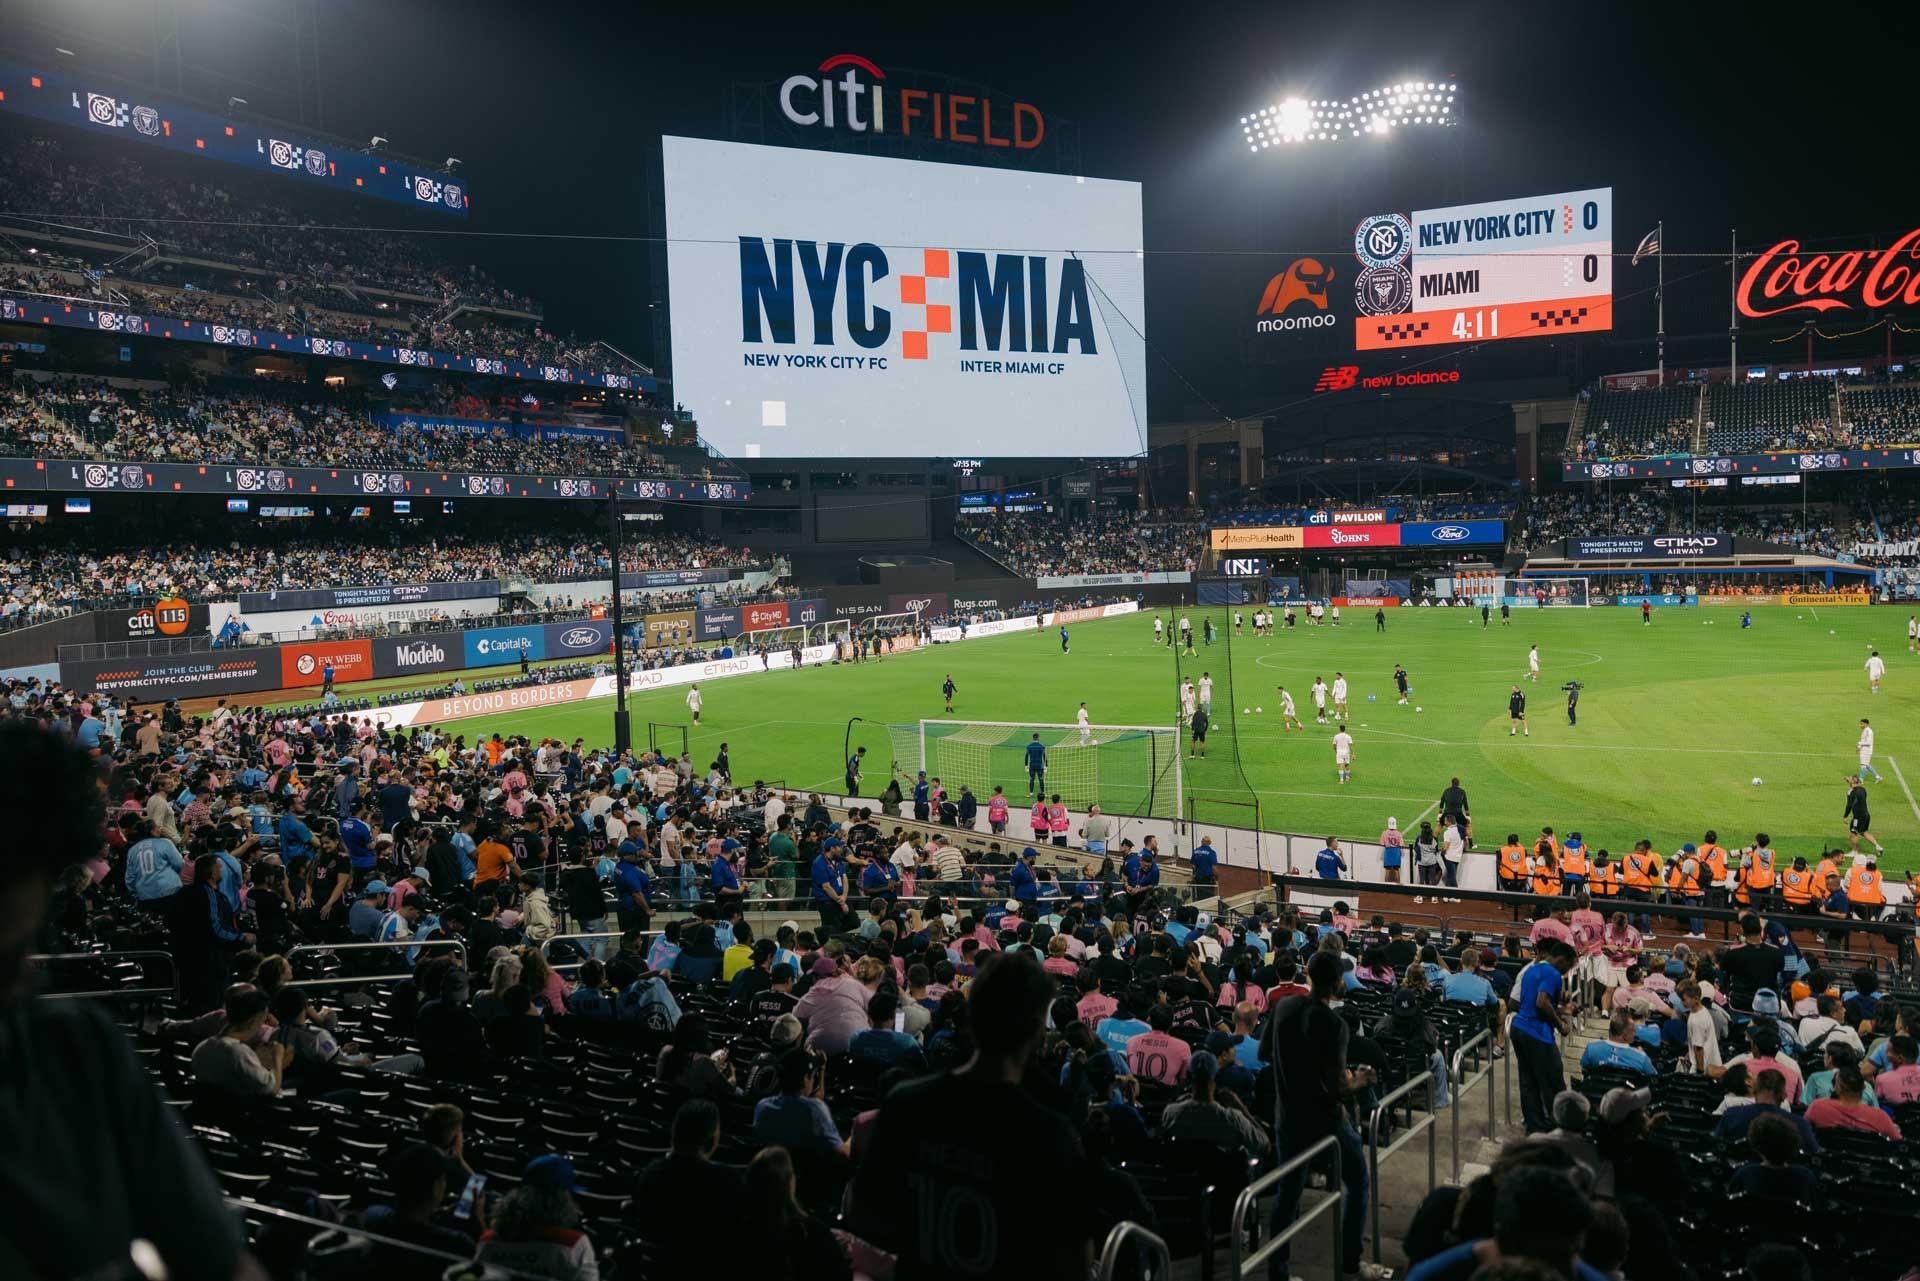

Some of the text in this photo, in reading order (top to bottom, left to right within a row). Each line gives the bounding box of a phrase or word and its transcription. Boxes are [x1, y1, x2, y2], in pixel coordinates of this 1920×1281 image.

[779, 66, 1045, 149] citi FIELD
[1583, 201, 1598, 230] 0
[1419, 208, 1556, 248] NEW YORK CITY
[1583, 254, 1598, 283] 0
[1420, 269, 1480, 298] MIAMI
[738, 236, 891, 349] NYC
[957, 251, 1098, 355] MIA
[1257, 314, 1336, 332] moomoo
[1452, 308, 1499, 339] 4:11
[744, 353, 888, 370] NEW YORK CITY FC
[960, 360, 1065, 375] INTER MIAMI CF
[1362, 375, 1394, 389] new
[1396, 370, 1460, 387] balance
[970, 460, 981, 468] PM
[1310, 511, 1383, 523] citi PAVILION
[1653, 537, 1718, 547] ETIHAD
[333, 588, 390, 598] TONIGHT'S MATCH
[393, 586, 429, 595] ETIHAD
[954, 599, 998, 610] Rugs.com
[1789, 595, 1864, 605] Continental Tire
[323, 608, 440, 625] Coors LIGHT FIESTA DECK
[760, 610, 782, 622] CityMD
[801, 607, 816, 622] citi
[836, 605, 882, 615] NISSAN
[128, 609, 185, 628] citi 115
[650, 619, 689, 631] ETIHAD
[490, 637, 532, 653] Capital Rx
[568, 630, 593, 645] Ford
[335, 653, 362, 664] WEBB
[396, 644, 445, 666] Modelo
[168, 667, 186, 675] THE
[188, 664, 214, 673] CLUB:
[703, 660, 749, 676] ETIHAD
[96, 669, 258, 690] NEWYORKCITYFC.COM/MEMBERSHIP
[443, 684, 573, 716] BEYOND BORDERS
[512, 842, 528, 860] 10
[138, 849, 155, 875] 10
[759, 1001, 781, 1011] MESSI
[1083, 1006, 1106, 1015] MESSI
[1172, 1006, 1193, 1020] MESSI
[1108, 1032, 1129, 1043] MESS
[1141, 1038, 1169, 1049] MESSI
[1135, 1051, 1167, 1081] 10
[904, 1170, 999, 1273] 10
